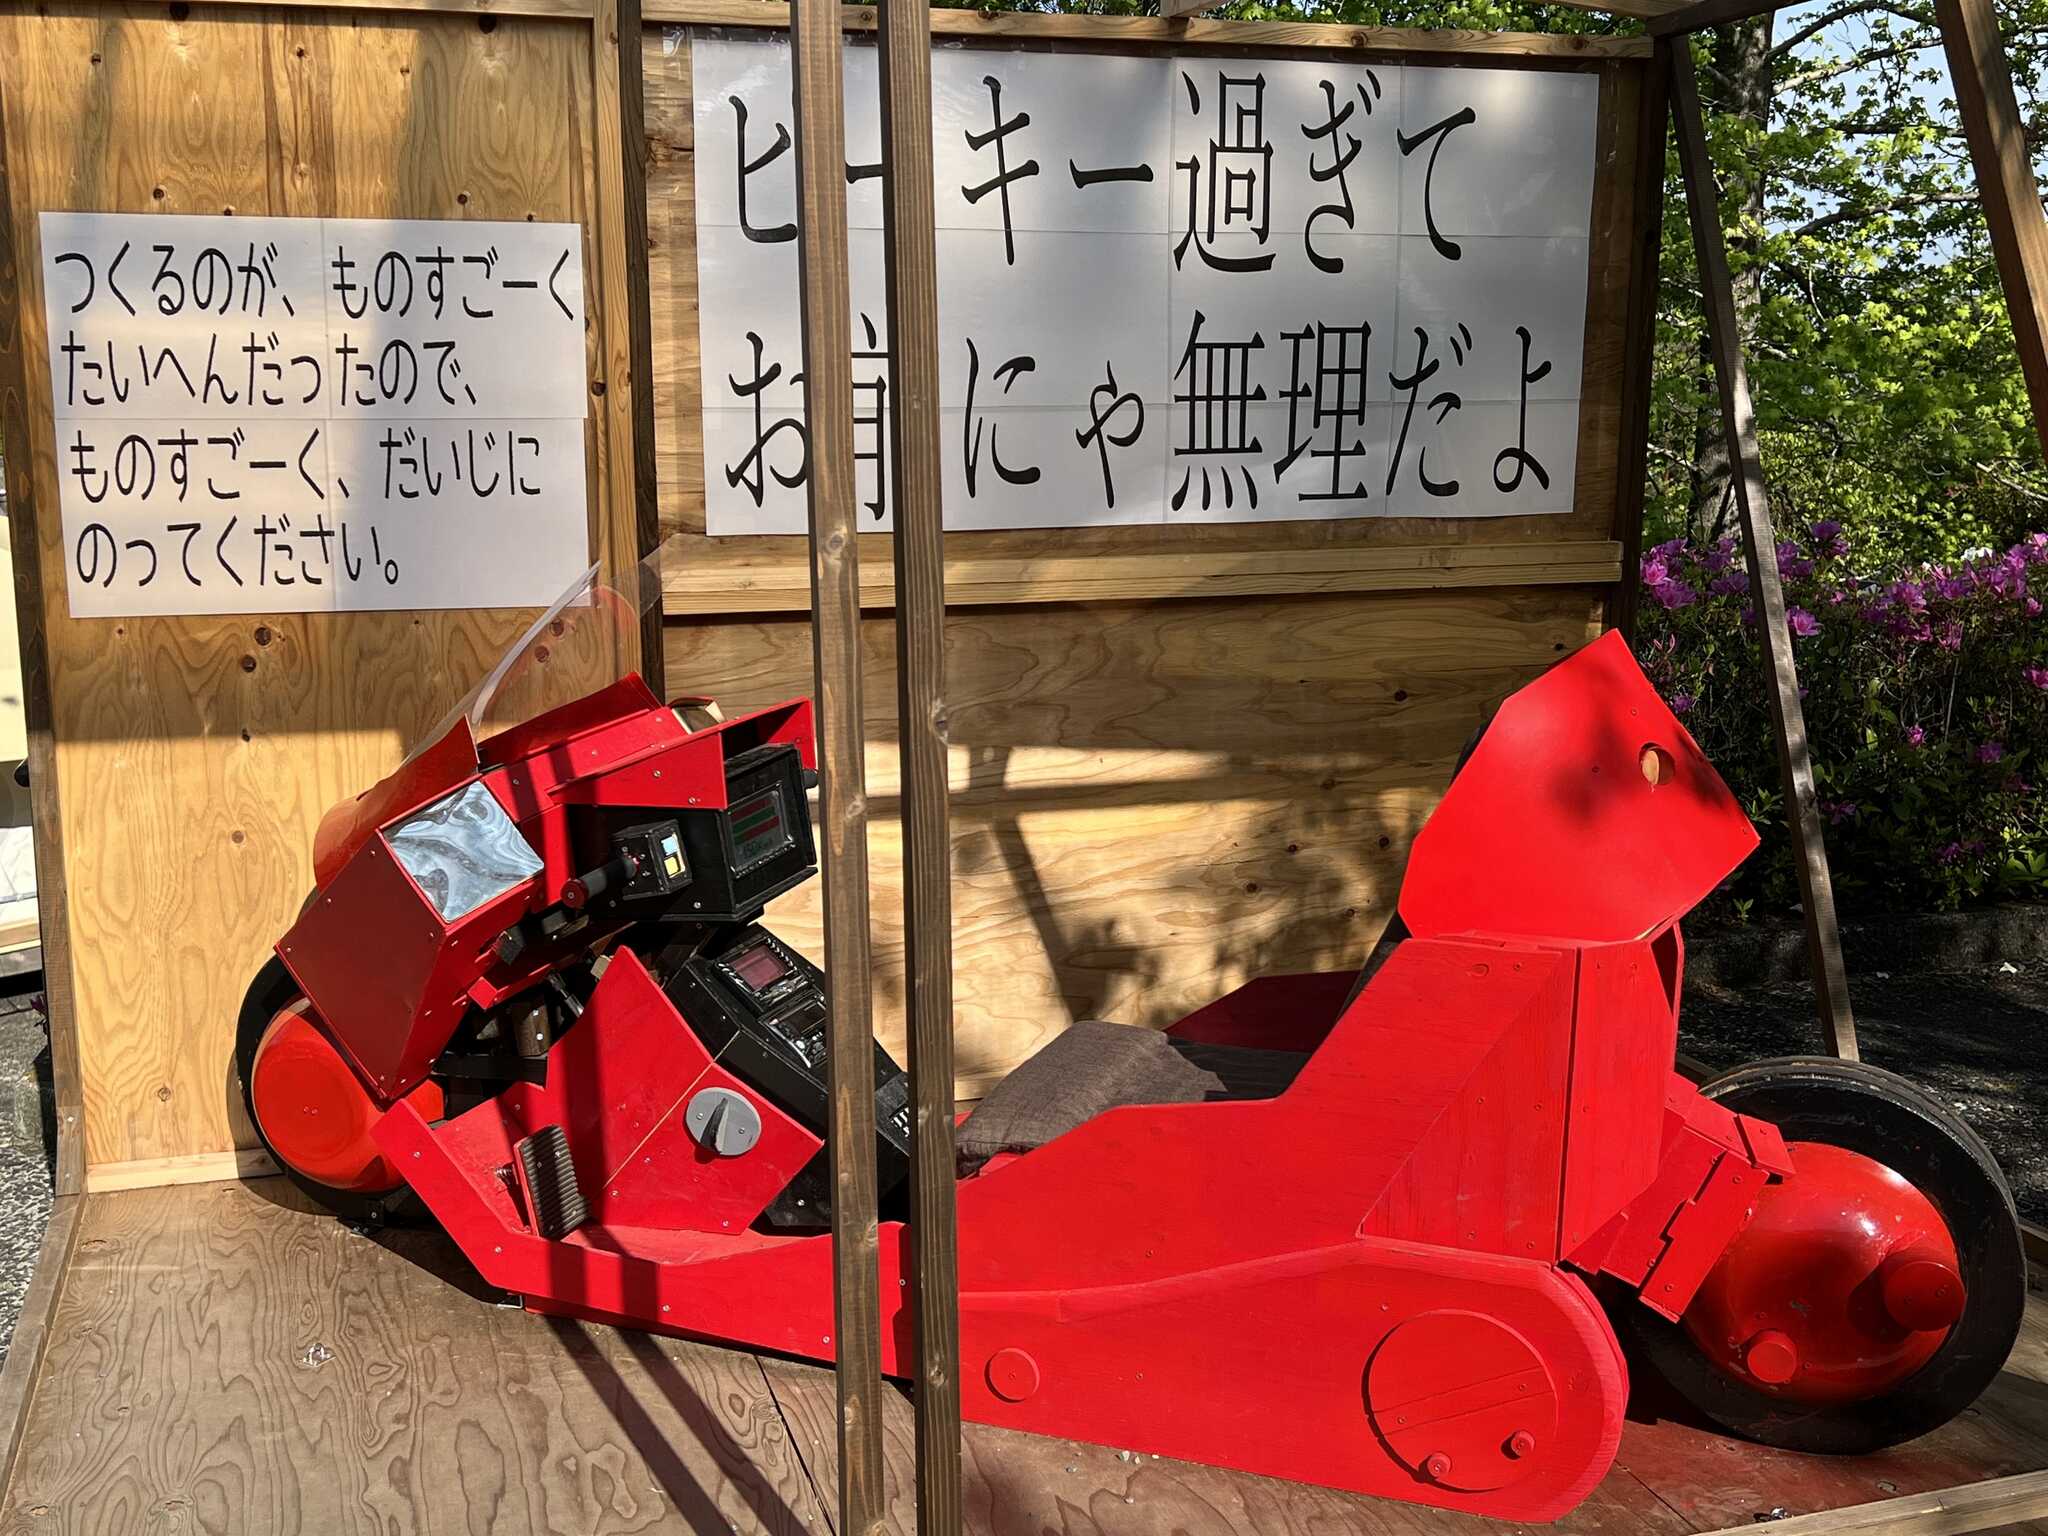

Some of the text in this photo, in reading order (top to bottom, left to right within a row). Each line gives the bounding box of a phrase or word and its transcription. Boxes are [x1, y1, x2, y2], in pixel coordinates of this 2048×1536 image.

[61, 331, 477, 405] たいへんだったので、
[76, 513, 399, 587] のってください。
